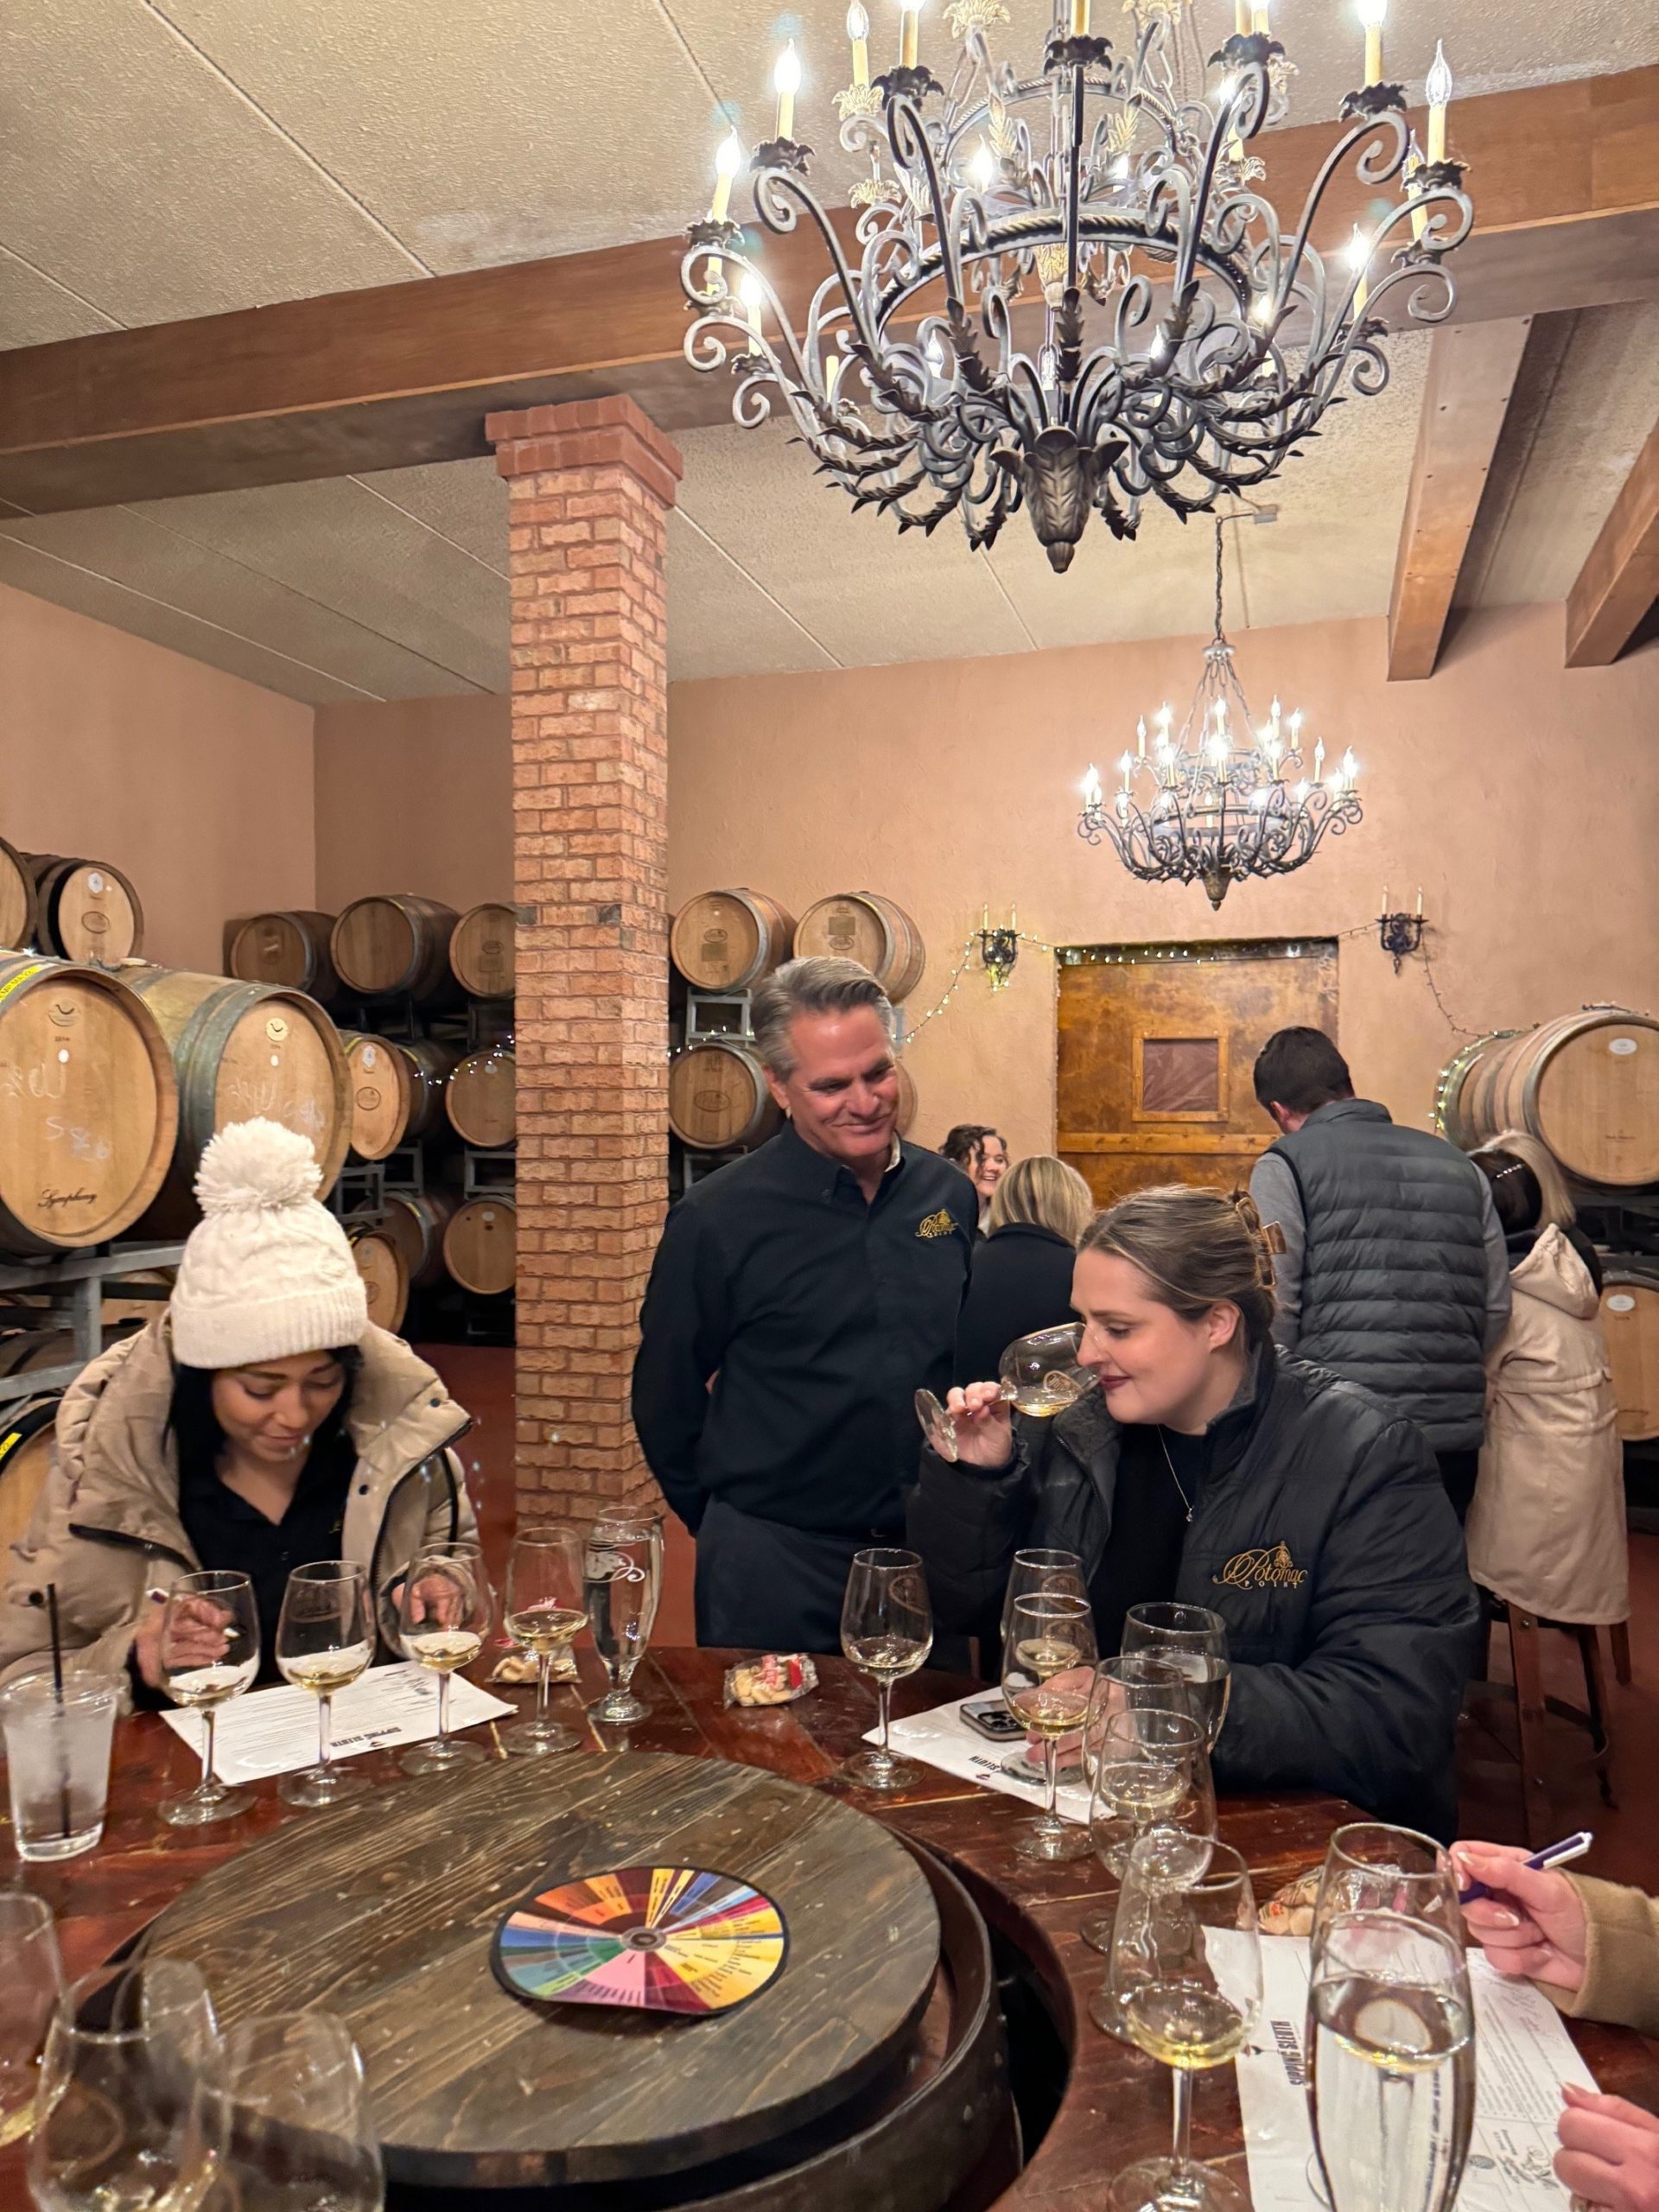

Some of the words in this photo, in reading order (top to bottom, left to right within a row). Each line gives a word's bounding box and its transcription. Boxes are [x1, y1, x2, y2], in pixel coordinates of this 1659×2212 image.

[1212, 1545, 1308, 1590] Potomac
[1244, 1580, 1298, 1589] POINT
[1270, 2020, 1299, 2050] SLEUTH
